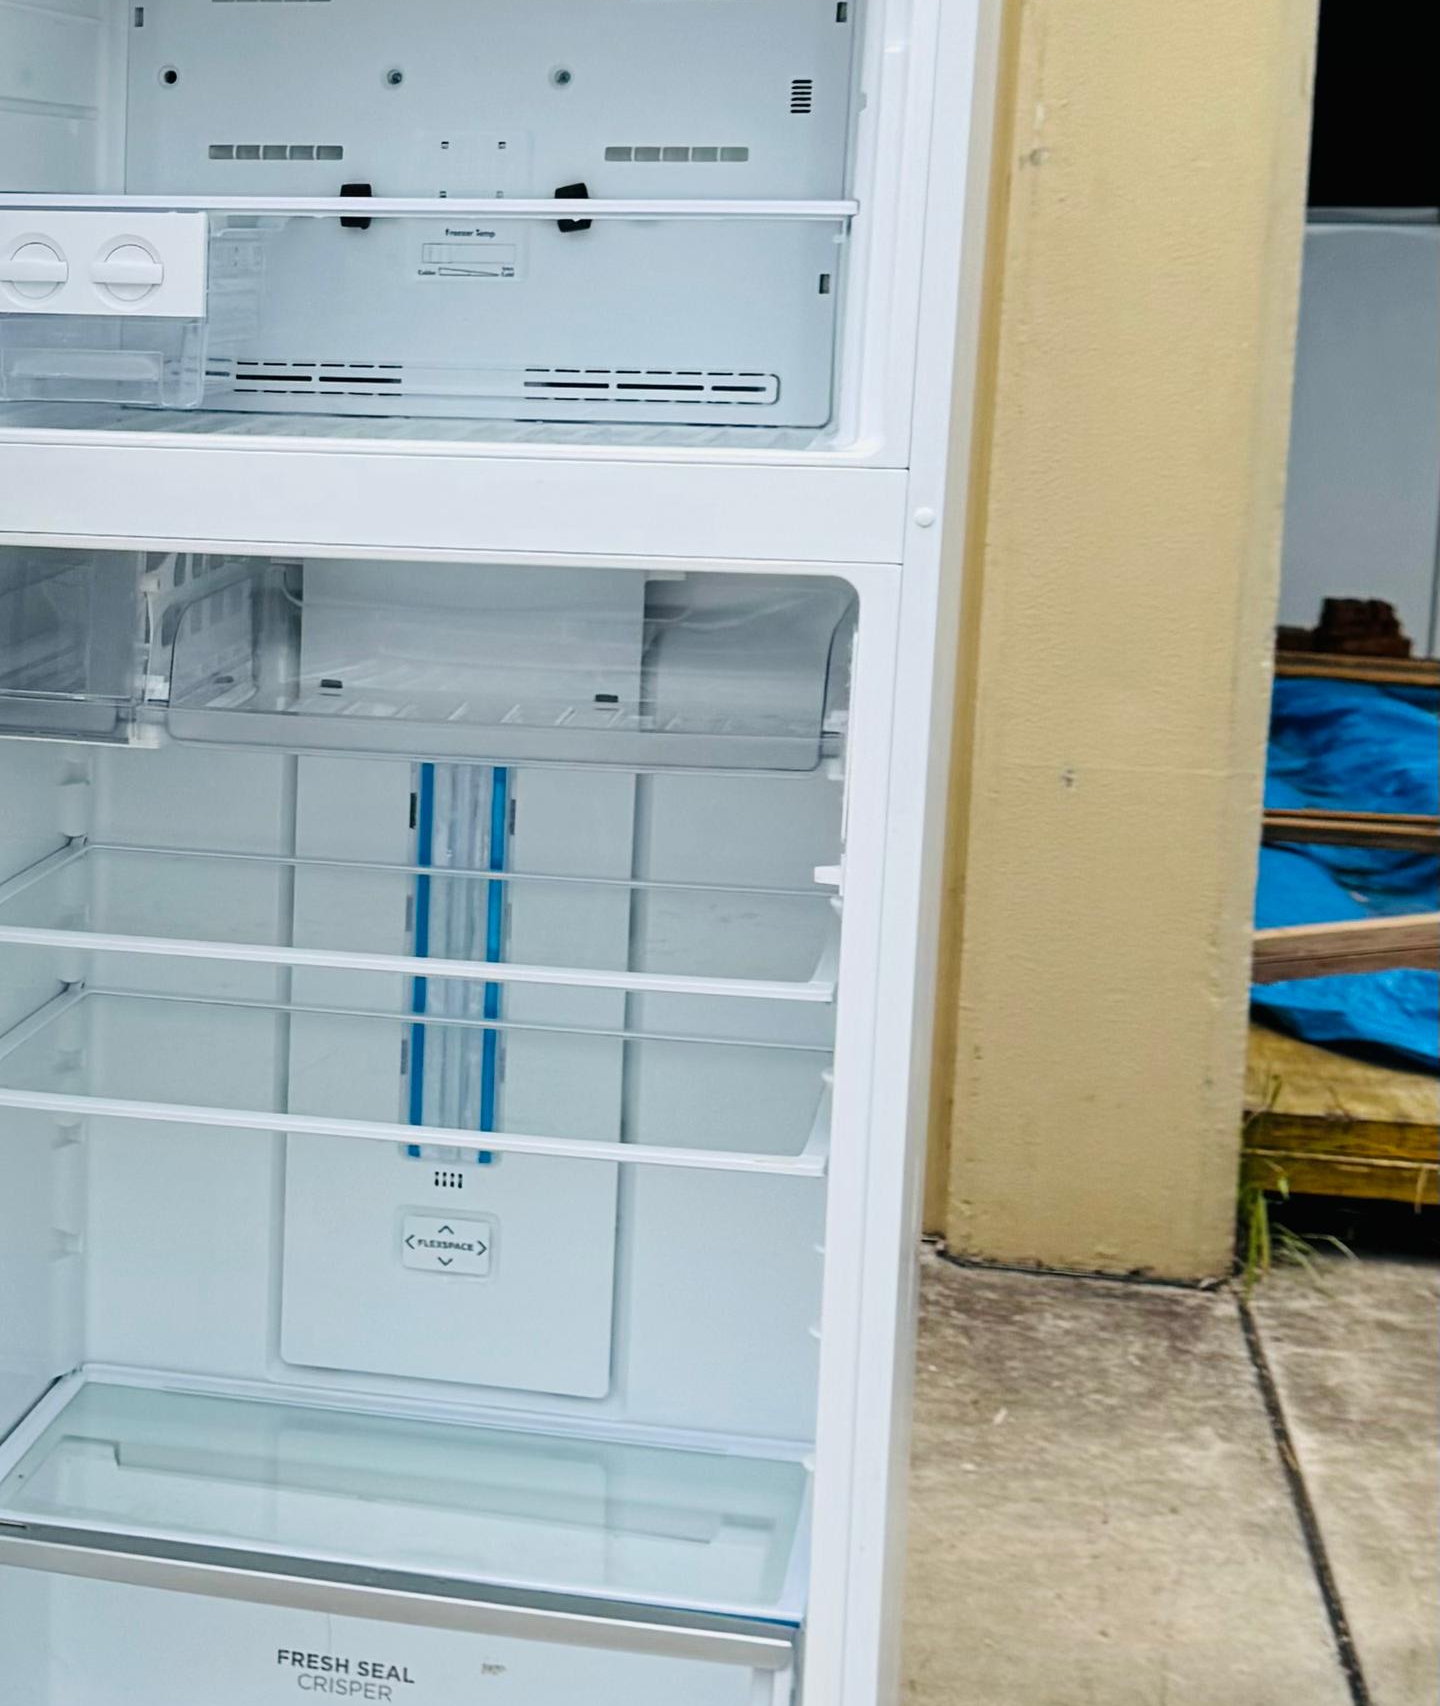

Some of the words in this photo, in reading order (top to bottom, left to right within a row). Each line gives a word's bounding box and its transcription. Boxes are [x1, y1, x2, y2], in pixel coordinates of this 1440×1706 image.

[277, 1649, 350, 1674] FRESH
[357, 1661, 415, 1684] SEAL
[297, 1673, 393, 1702] CRISPER
